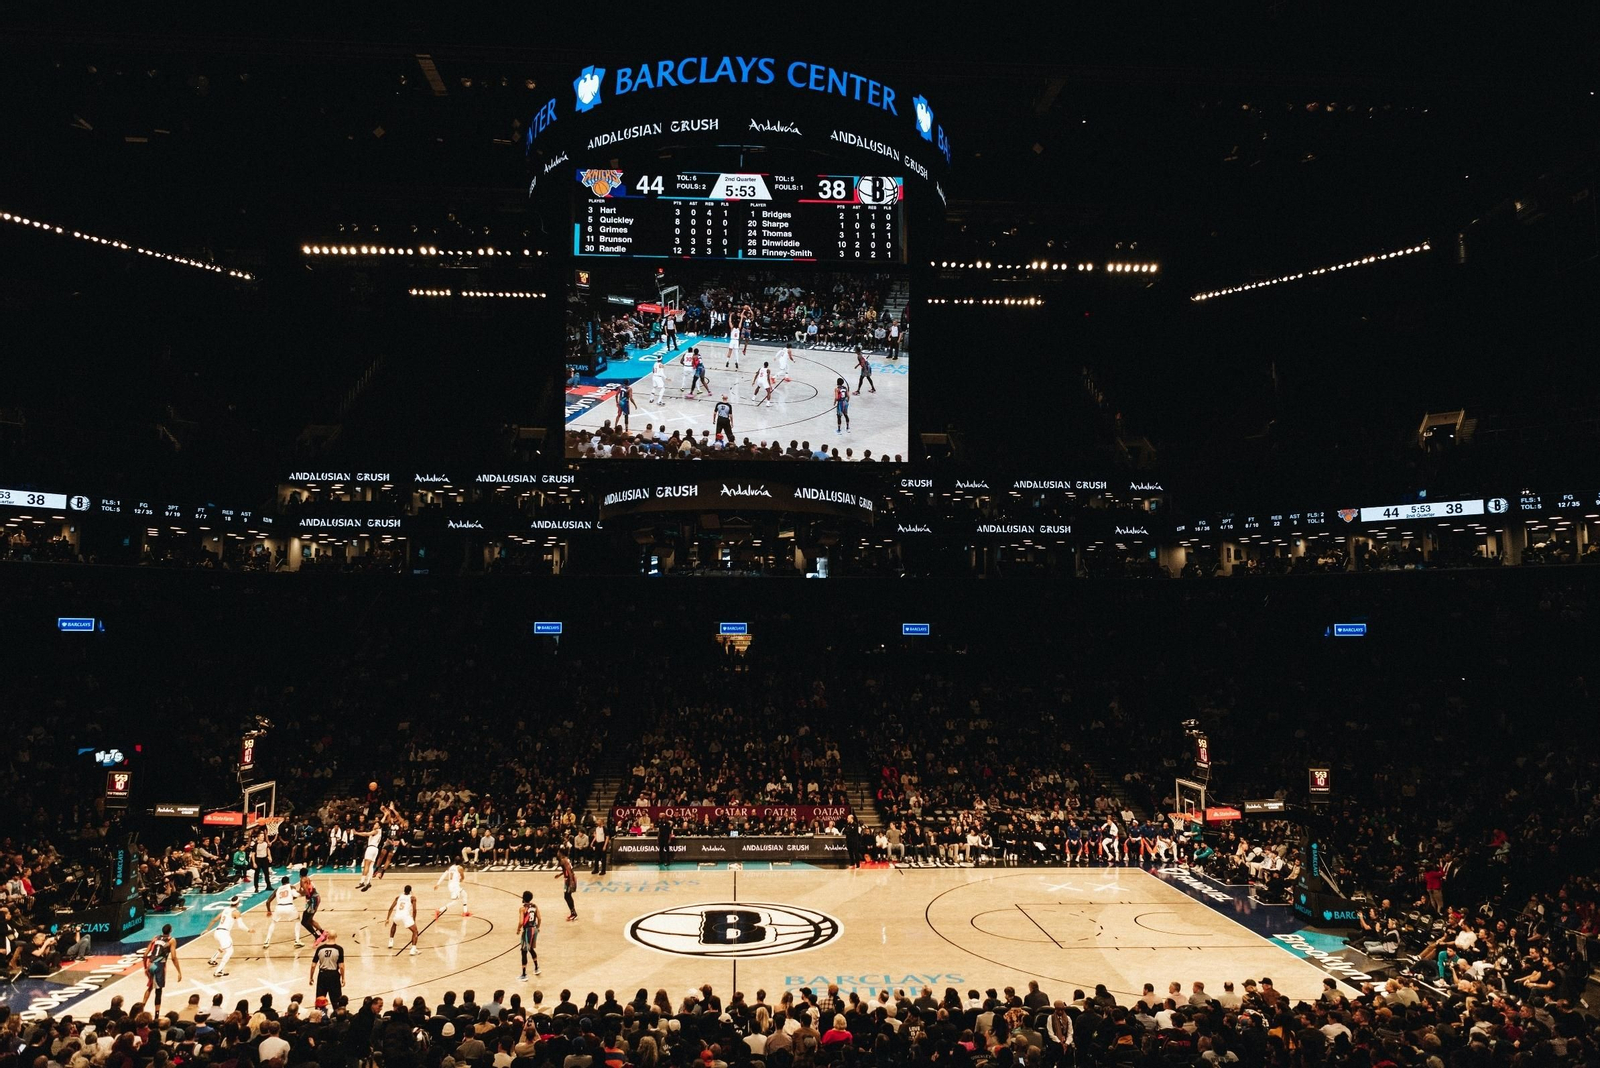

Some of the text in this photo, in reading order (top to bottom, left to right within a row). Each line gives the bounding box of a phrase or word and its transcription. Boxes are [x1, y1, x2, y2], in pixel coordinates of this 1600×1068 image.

[616, 56, 897, 115] BARCLAYS CENTER
[588, 119, 718, 150] ANDALUSIAN CRUSH
[830, 130, 928, 180] ANDALUSIAN CRUSH
[585, 169, 618, 182] KNICKS
[636, 175, 664, 194] 44
[818, 180, 846, 199] 38
[872, 178, 885, 202] B
[726, 185, 756, 197] 5:53
[600, 216, 634, 225] Quickley
[762, 211, 791, 219] Bridges
[762, 220, 789, 229] Sharpe
[599, 235, 632, 243] Brunson
[762, 239, 800, 247] Dinwiddie
[762, 249, 812, 258] Finney-Smith
[289, 472, 390, 481] ANDALUSIAN CRUSH
[476, 474, 574, 483] ANDALUSIAN CRUSH
[901, 479, 932, 487] CRUSH
[1014, 481, 1106, 489] ANDALUSIAN CRUSH
[27, 494, 45, 505] 38
[604, 485, 698, 505] ANDALUSIAN CRUSH
[794, 488, 856, 505] ANDALUSIAN
[1383, 507, 1399, 518] 44
[1411, 505, 1431, 513] 5:53
[1446, 503, 1463, 514] 38
[299, 519, 401, 527] ANDALUSIAN CRUSH
[531, 521, 591, 529] ANDALUSIAN
[977, 525, 1071, 533] ANDALUSIAN CRUSH
[698, 910, 777, 945] B
[1273, 934, 1372, 980] Brooklyn
[785, 973, 965, 985] BARCLAYS
